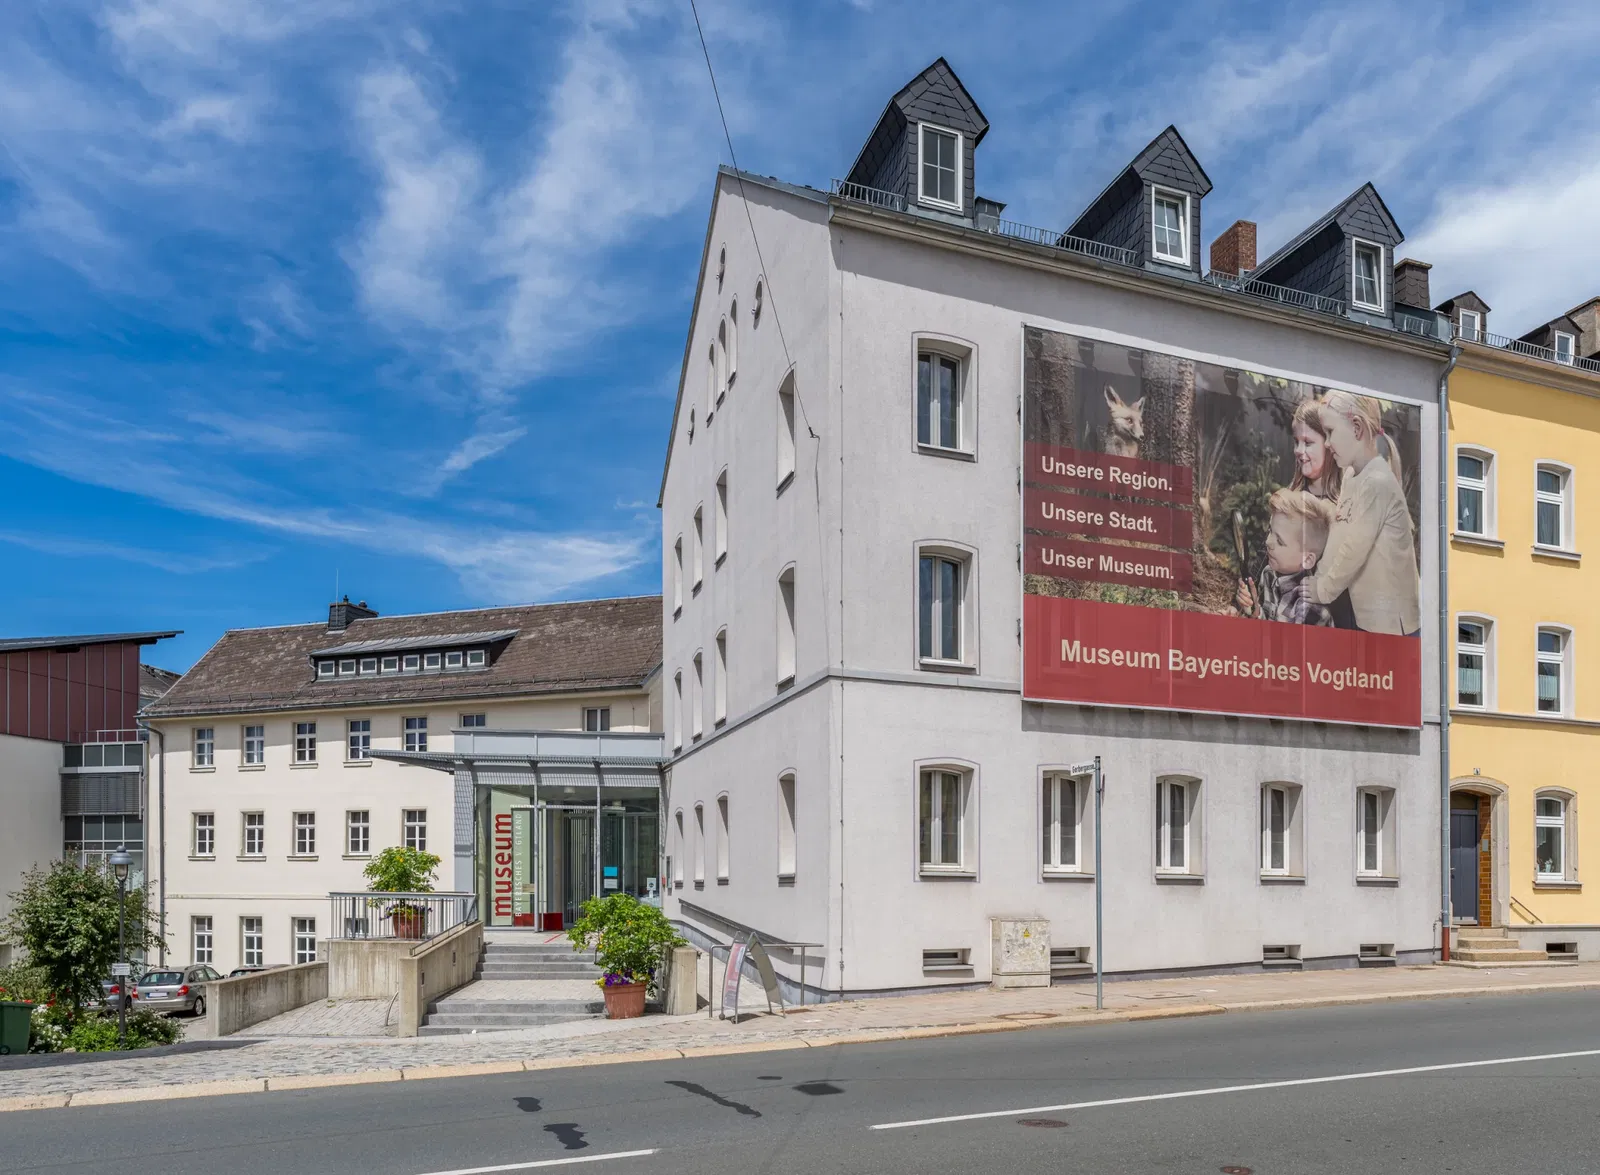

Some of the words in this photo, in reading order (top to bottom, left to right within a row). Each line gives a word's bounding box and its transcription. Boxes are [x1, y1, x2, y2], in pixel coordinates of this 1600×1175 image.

[1042, 456, 1104, 481] Unsere
[1109, 466, 1173, 491] Region.
[1042, 502, 1104, 526] Unsere
[1109, 511, 1157, 533] Stadt.
[1042, 548, 1094, 570] Unser
[1099, 555, 1175, 580] Museum.
[1061, 639, 1161, 670] Museum
[1168, 649, 1301, 682] Bayerisches
[1307, 662, 1394, 691] Vogtland
[495, 814, 512, 917] museum
